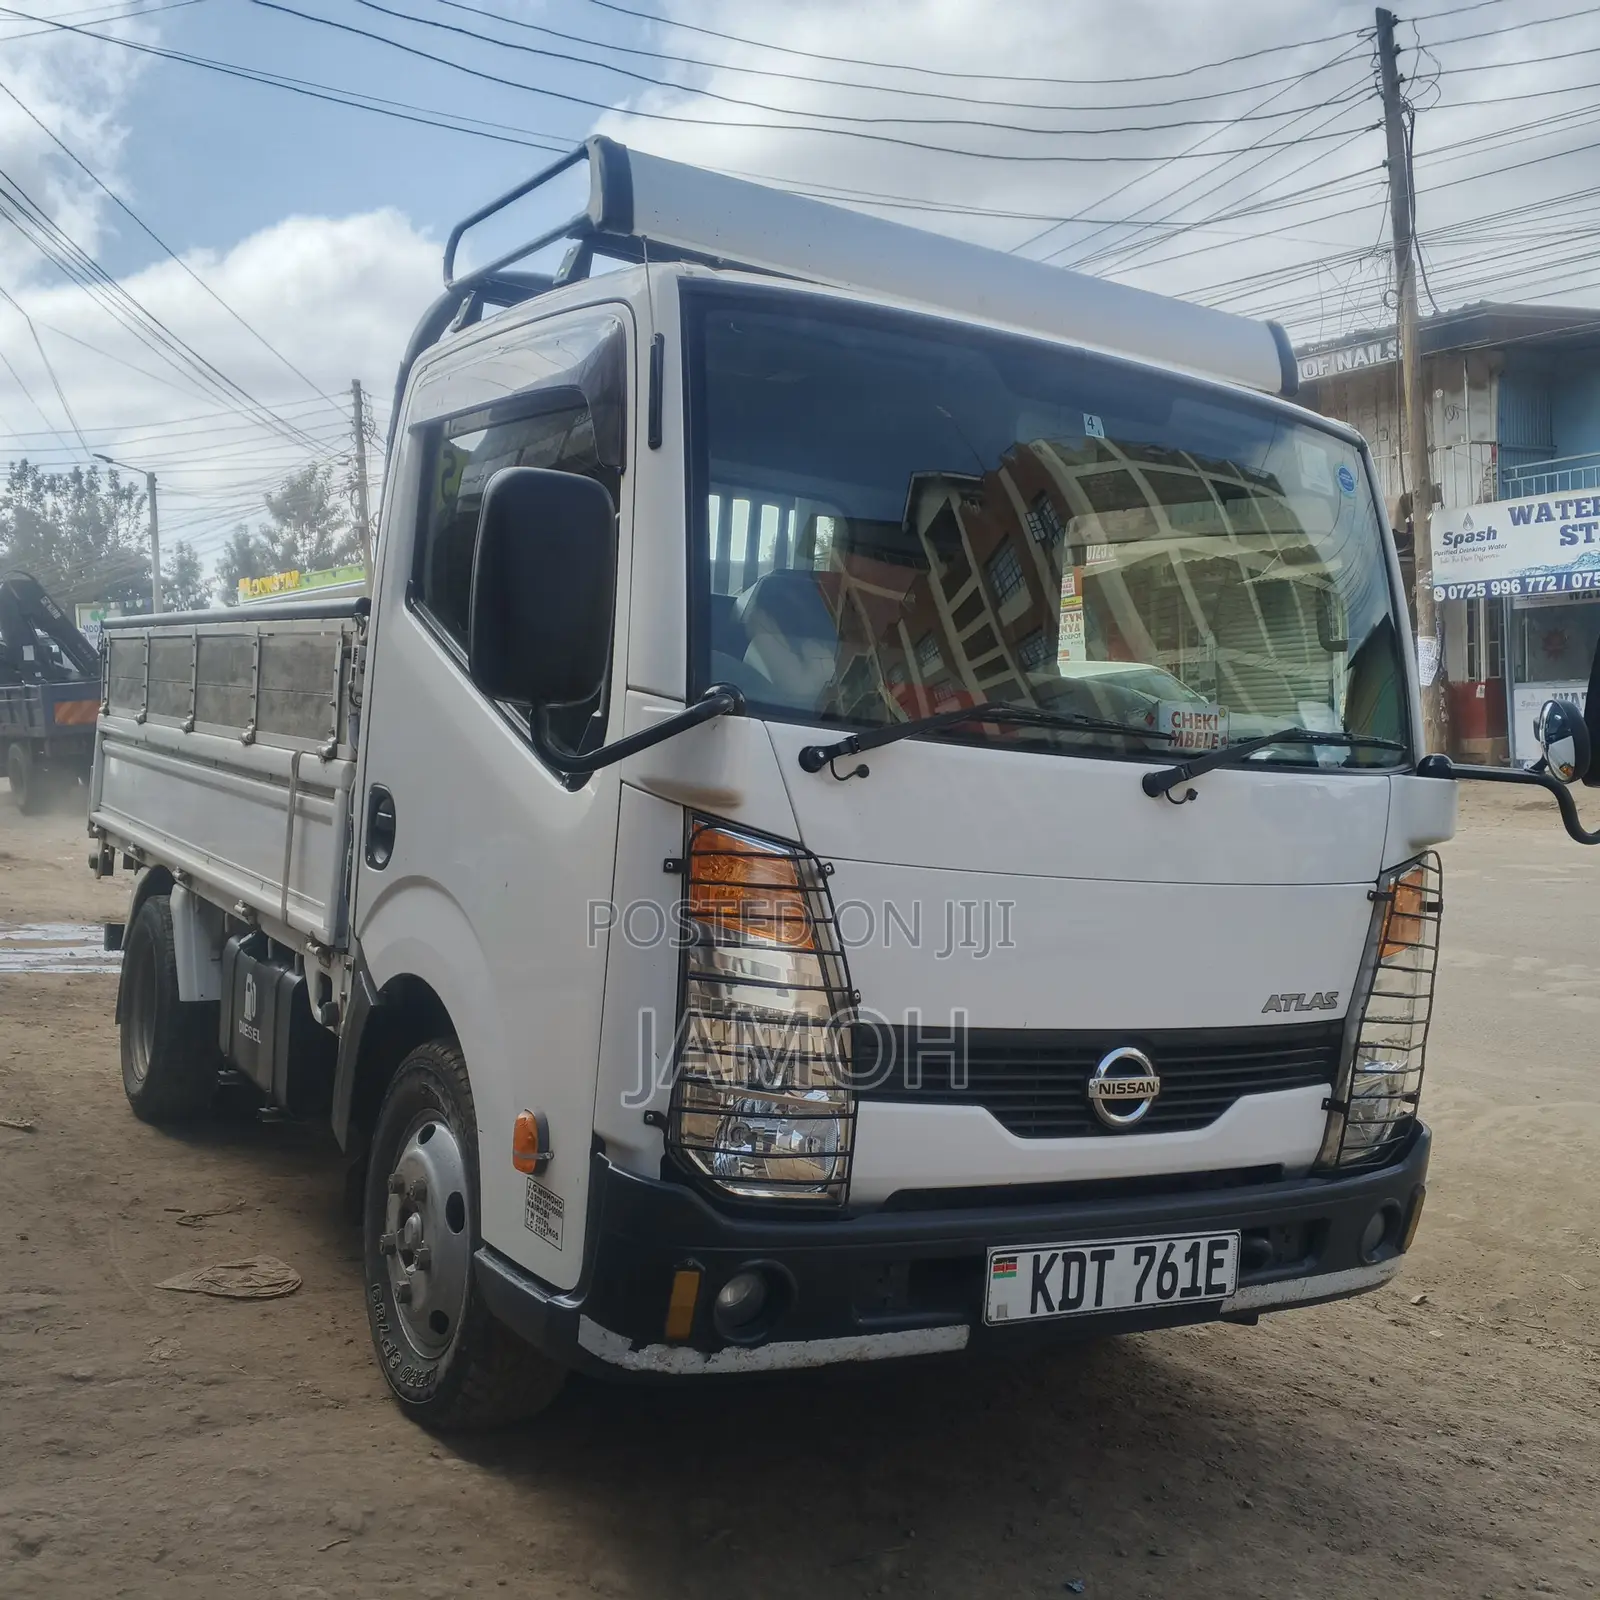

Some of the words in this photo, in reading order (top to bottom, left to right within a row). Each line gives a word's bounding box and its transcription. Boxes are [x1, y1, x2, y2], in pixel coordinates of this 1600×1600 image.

[1302, 356, 1329, 378] OF
[1337, 339, 1403, 371] NAILS
[1087, 416, 1095, 430] 4
[1442, 526, 1498, 548] Spash
[1560, 522, 1600, 546] ST
[1434, 548, 1458, 557] Purified
[1459, 545, 1486, 555] Drinking
[1488, 543, 1508, 551] Water
[1448, 582, 1486, 600] 0725
[1491, 578, 1521, 596] 996
[1525, 574, 1557, 592] 772
[1171, 711, 1218, 730] CHEKI
[1168, 730, 1219, 749] MBELE
[1261, 992, 1339, 1013] ATLAS
[239, 1019, 261, 1043] DIESEL
[1098, 1081, 1156, 1095] NISSAN
[1030, 1248, 1115, 1314] KDT
[1133, 1239, 1229, 1303] 761E
